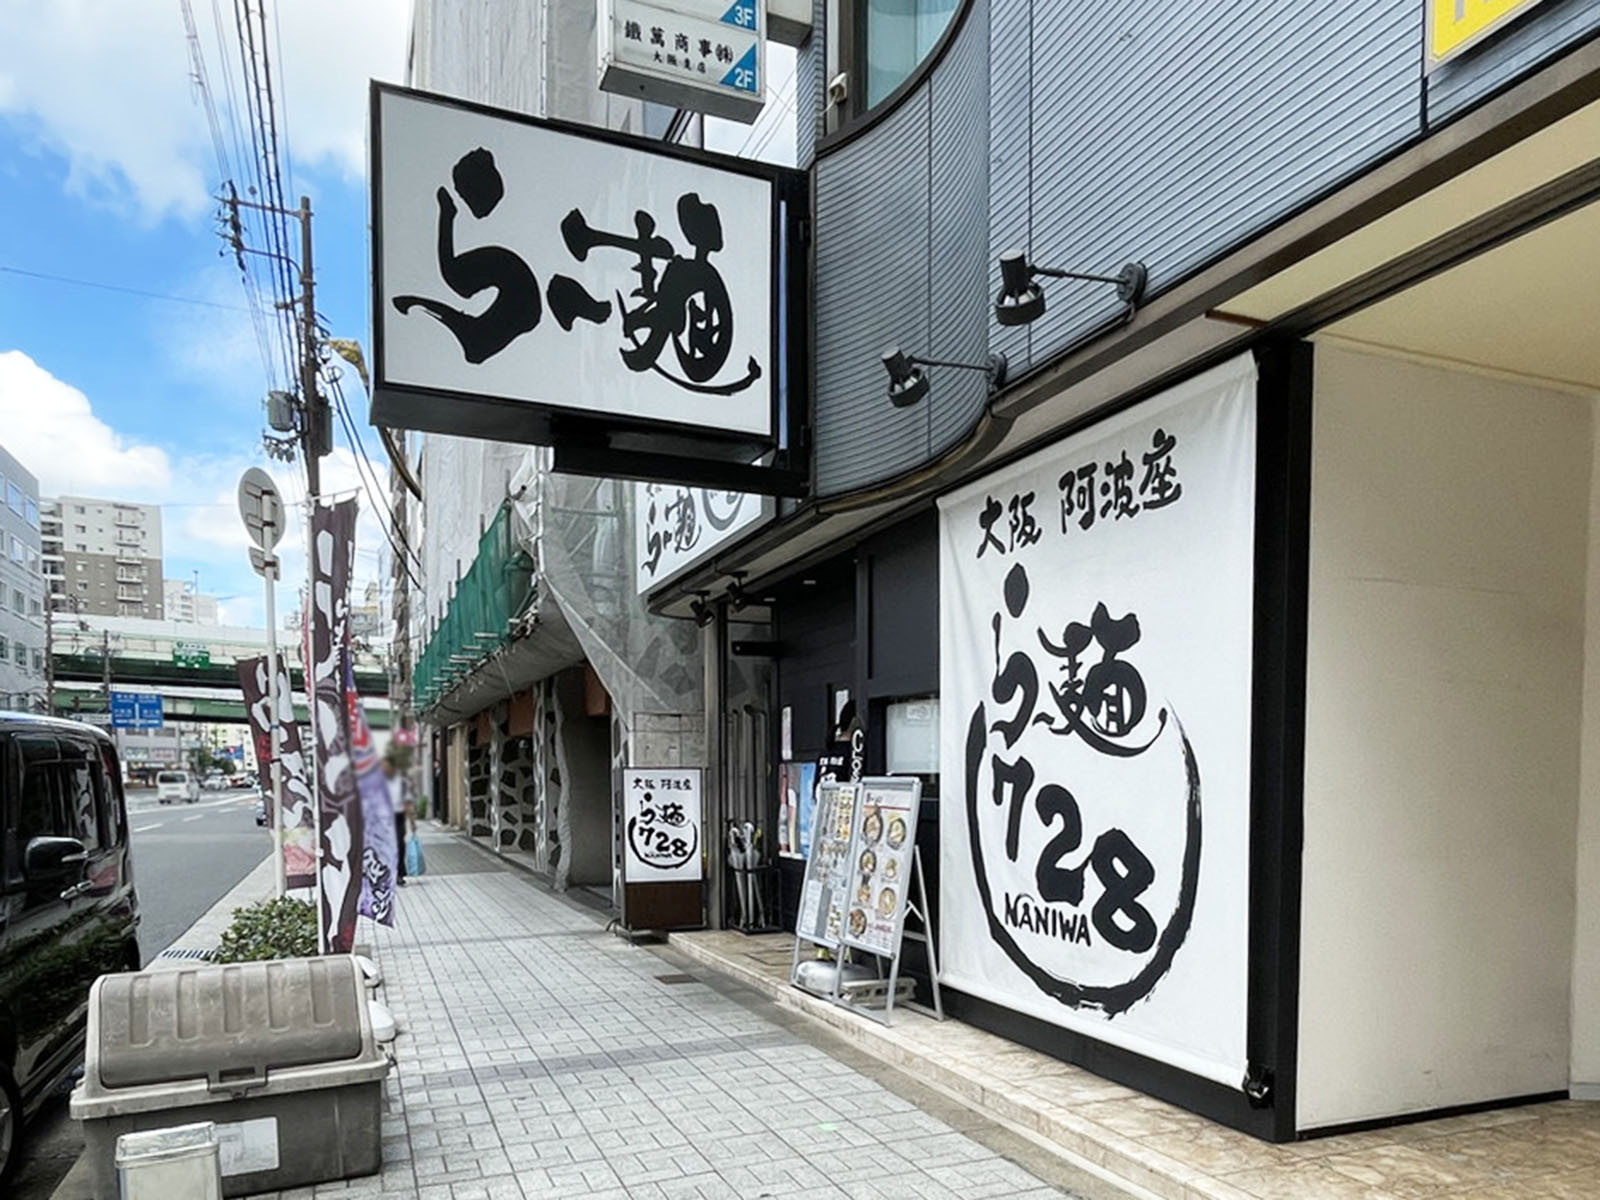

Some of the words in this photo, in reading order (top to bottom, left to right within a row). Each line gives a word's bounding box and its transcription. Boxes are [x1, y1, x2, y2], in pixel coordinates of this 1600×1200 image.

[734, 6, 754, 27] 3F
[734, 67, 754, 88] 2F
[976, 491, 1043, 559] 大阪
[1058, 428, 1182, 534] 阿波座
[639, 826, 688, 858] 728
[991, 753, 1158, 954] 728
[1004, 892, 1091, 947] NANIWA
